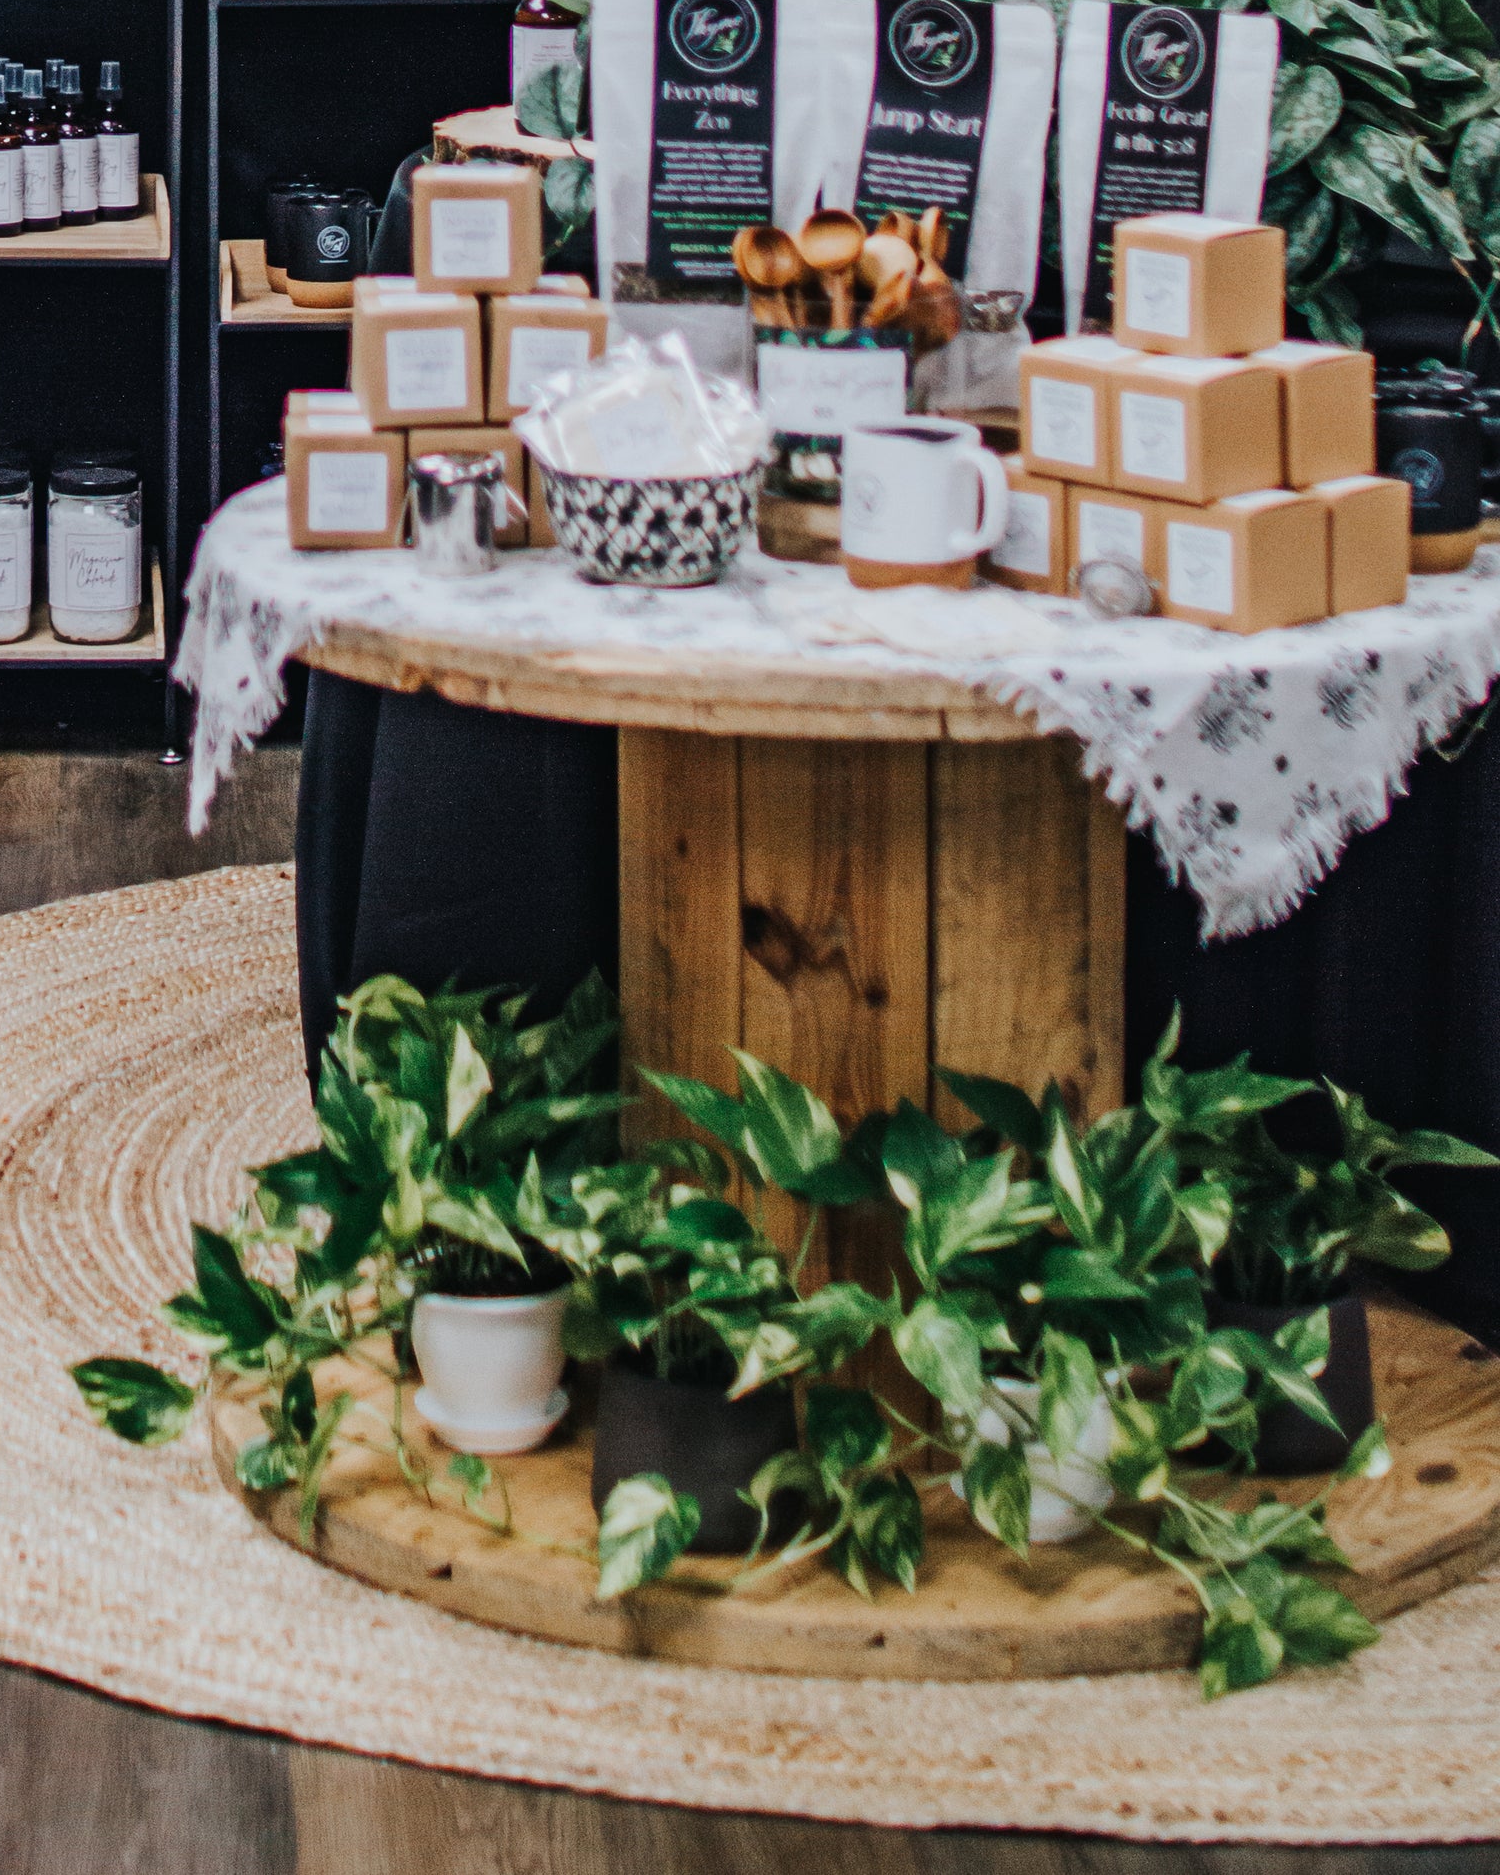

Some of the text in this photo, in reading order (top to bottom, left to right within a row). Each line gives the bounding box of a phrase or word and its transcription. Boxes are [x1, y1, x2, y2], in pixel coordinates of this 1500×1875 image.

[662, 80, 758, 107] Everything
[693, 110, 732, 130] Zen
[868, 101, 982, 137] Jump Start
